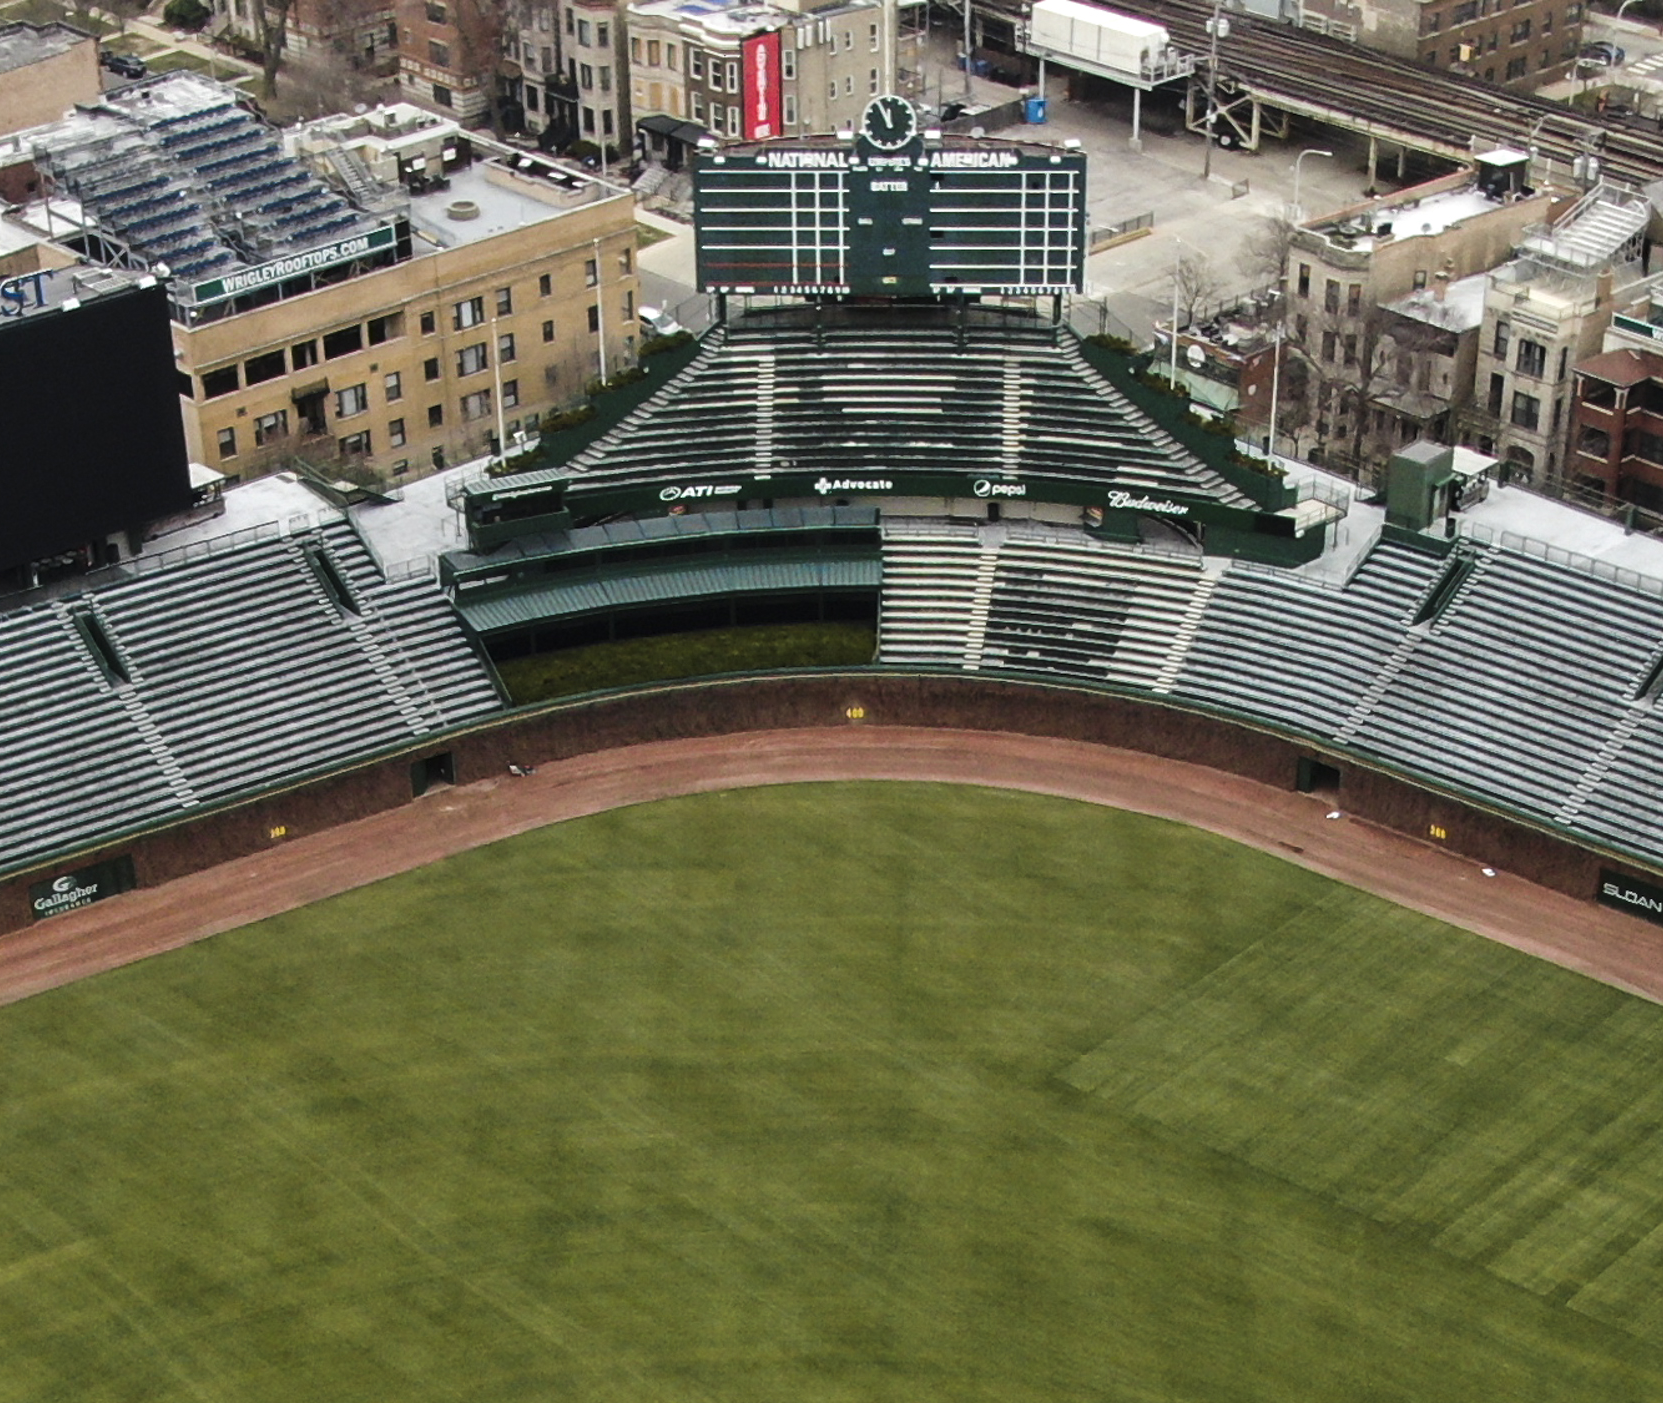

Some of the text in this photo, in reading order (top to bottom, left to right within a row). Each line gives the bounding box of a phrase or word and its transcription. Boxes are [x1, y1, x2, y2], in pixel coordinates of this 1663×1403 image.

[768, 153, 848, 168] NATIONAL
[930, 152, 1011, 168] AMERICAN
[222, 237, 369, 293] WRIGLEYROOFTOPS.COM
[680, 485, 714, 498] ATI
[832, 478, 893, 490] Advocate
[992, 484, 1026, 497] pepsi
[1108, 490, 1190, 516] Budweiser
[34, 881, 99, 910] Gallagher
[1603, 882, 1663, 913] SLOAN
